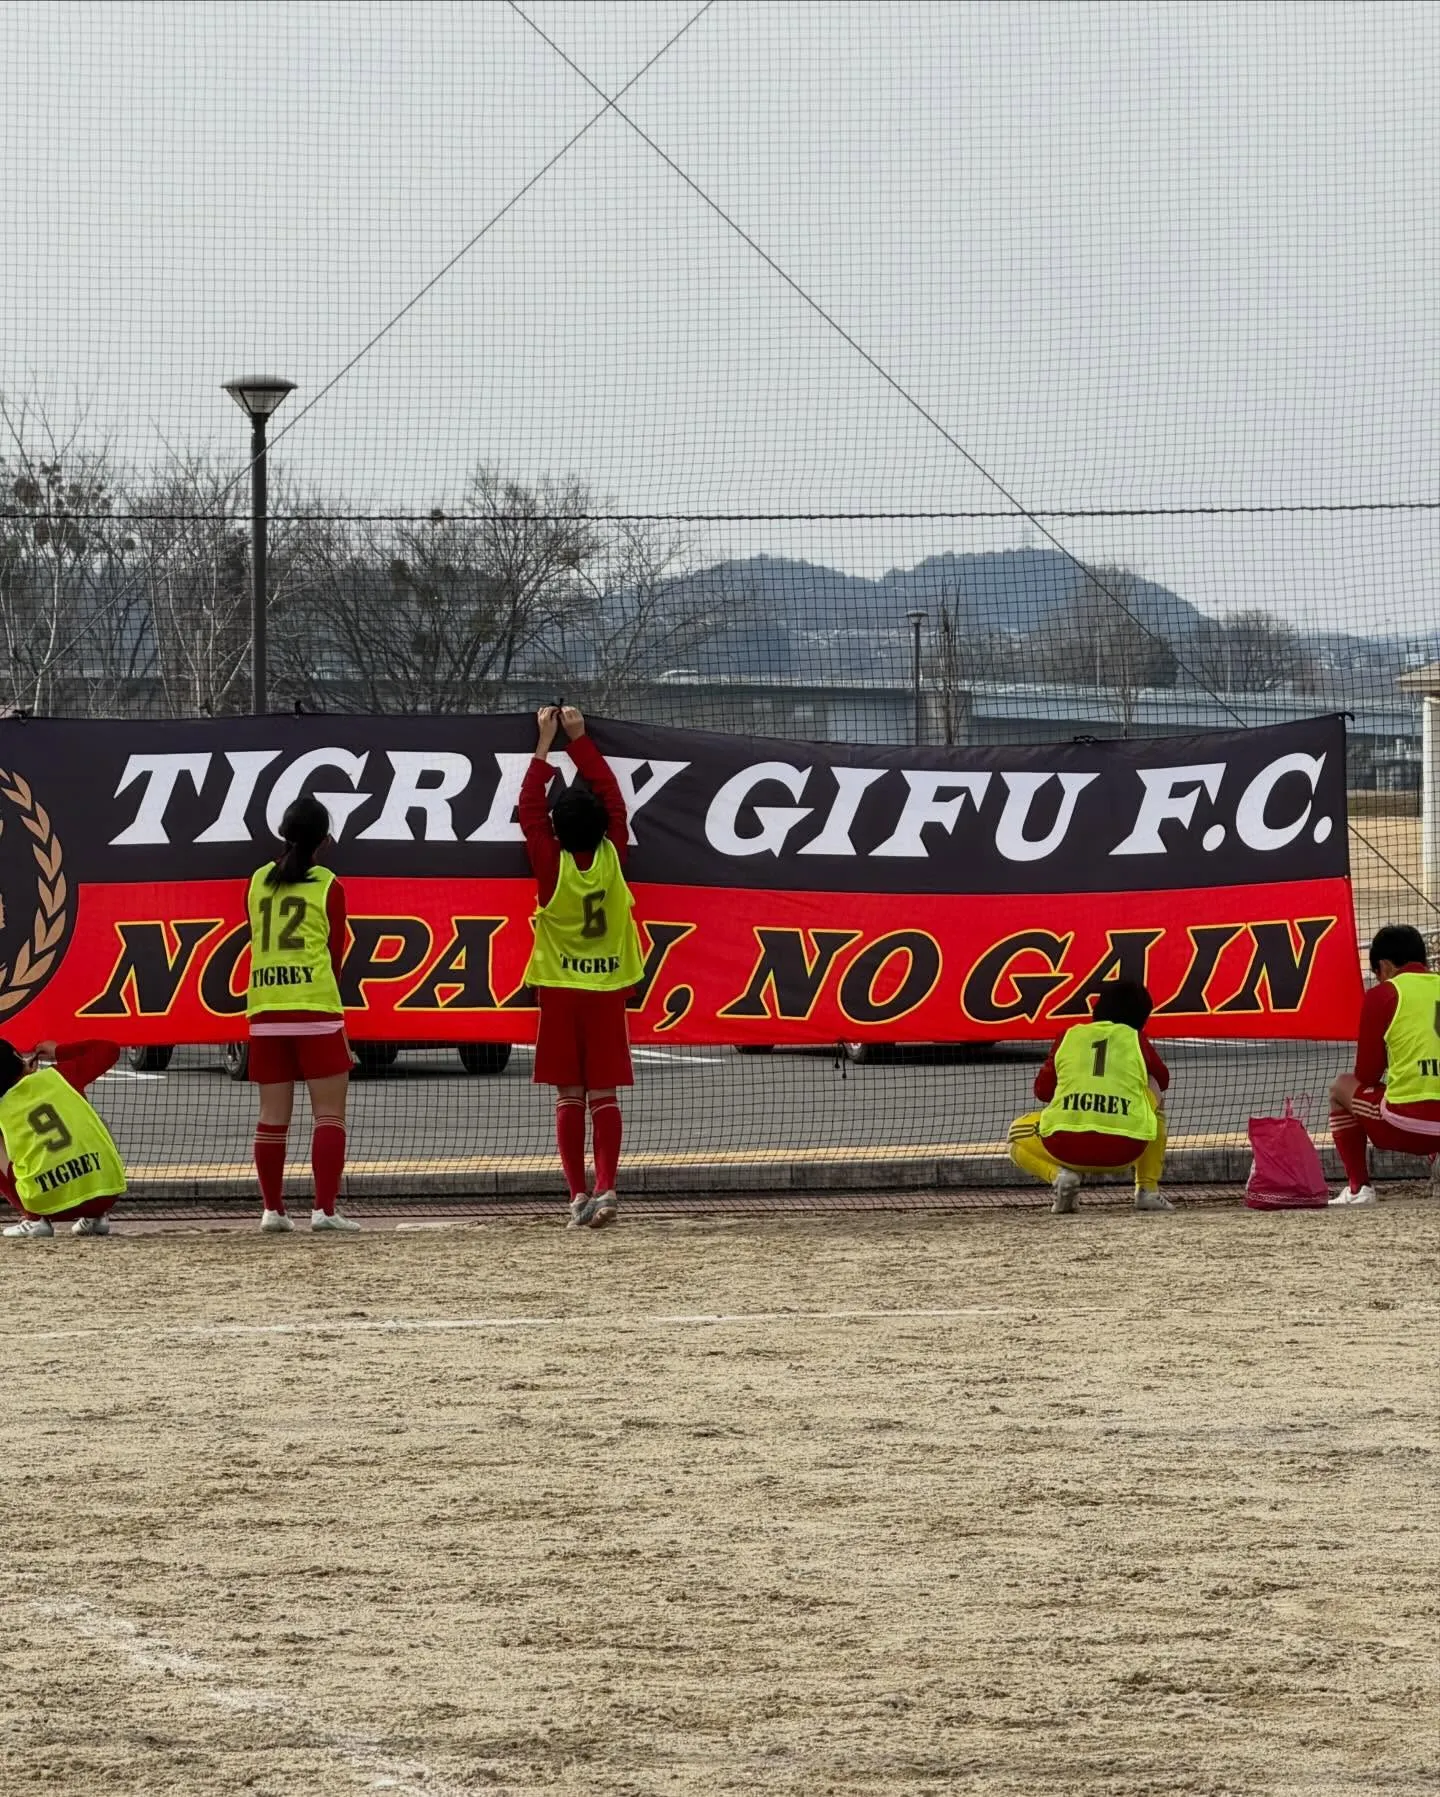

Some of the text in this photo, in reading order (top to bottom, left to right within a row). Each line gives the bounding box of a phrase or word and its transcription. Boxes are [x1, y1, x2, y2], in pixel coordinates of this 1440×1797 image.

[108, 746, 1333, 862] TIGREY GIFU F.C.
[258, 895, 307, 953] 12
[580, 889, 609, 940] 6
[252, 966, 314, 989] TIGREY
[716, 926, 943, 1026] NO
[960, 915, 1338, 1025] GAIN
[1091, 1038, 1109, 1078] 1
[1417, 1058, 1440, 1077] TI
[26, 1102, 73, 1153] 9
[1062, 1092, 1132, 1117] TIGREY
[34, 1151, 102, 1193] TIGREY
